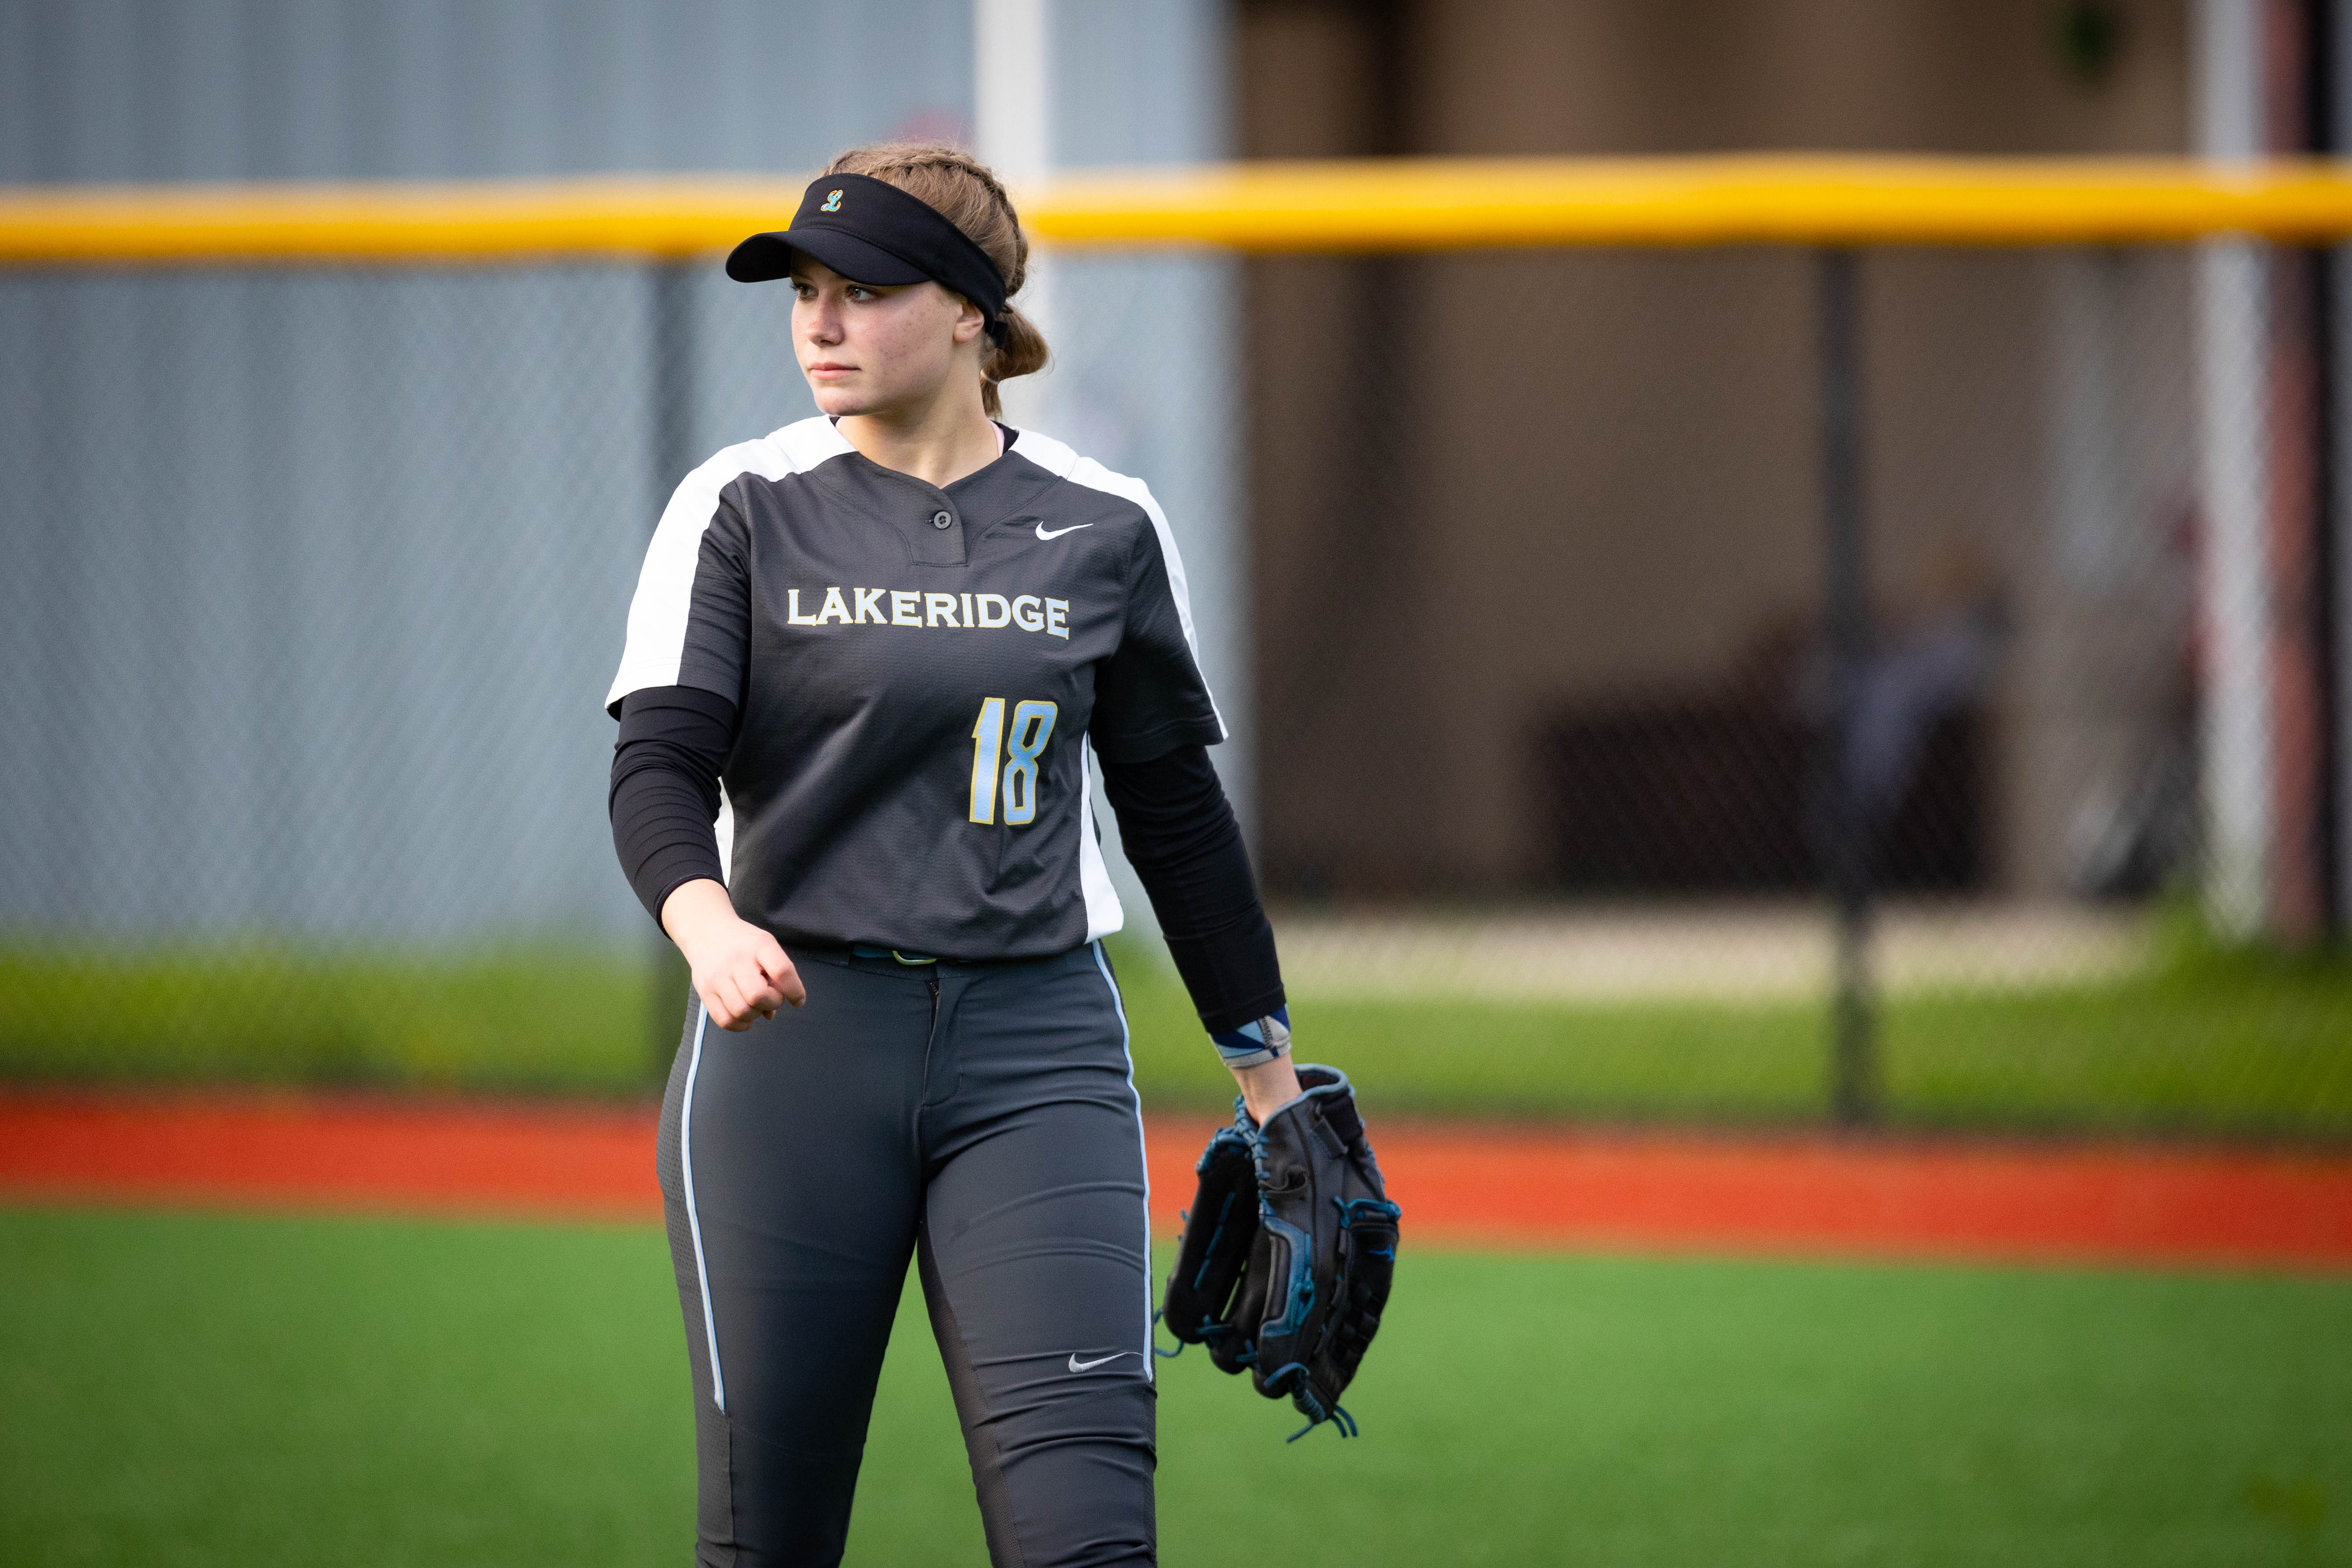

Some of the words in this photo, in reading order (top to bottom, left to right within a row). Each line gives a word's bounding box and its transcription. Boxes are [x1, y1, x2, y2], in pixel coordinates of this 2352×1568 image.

[821, 190, 843, 212] L
[788, 587, 1069, 640] LAKERIDGE
[969, 697, 1058, 825] 18
